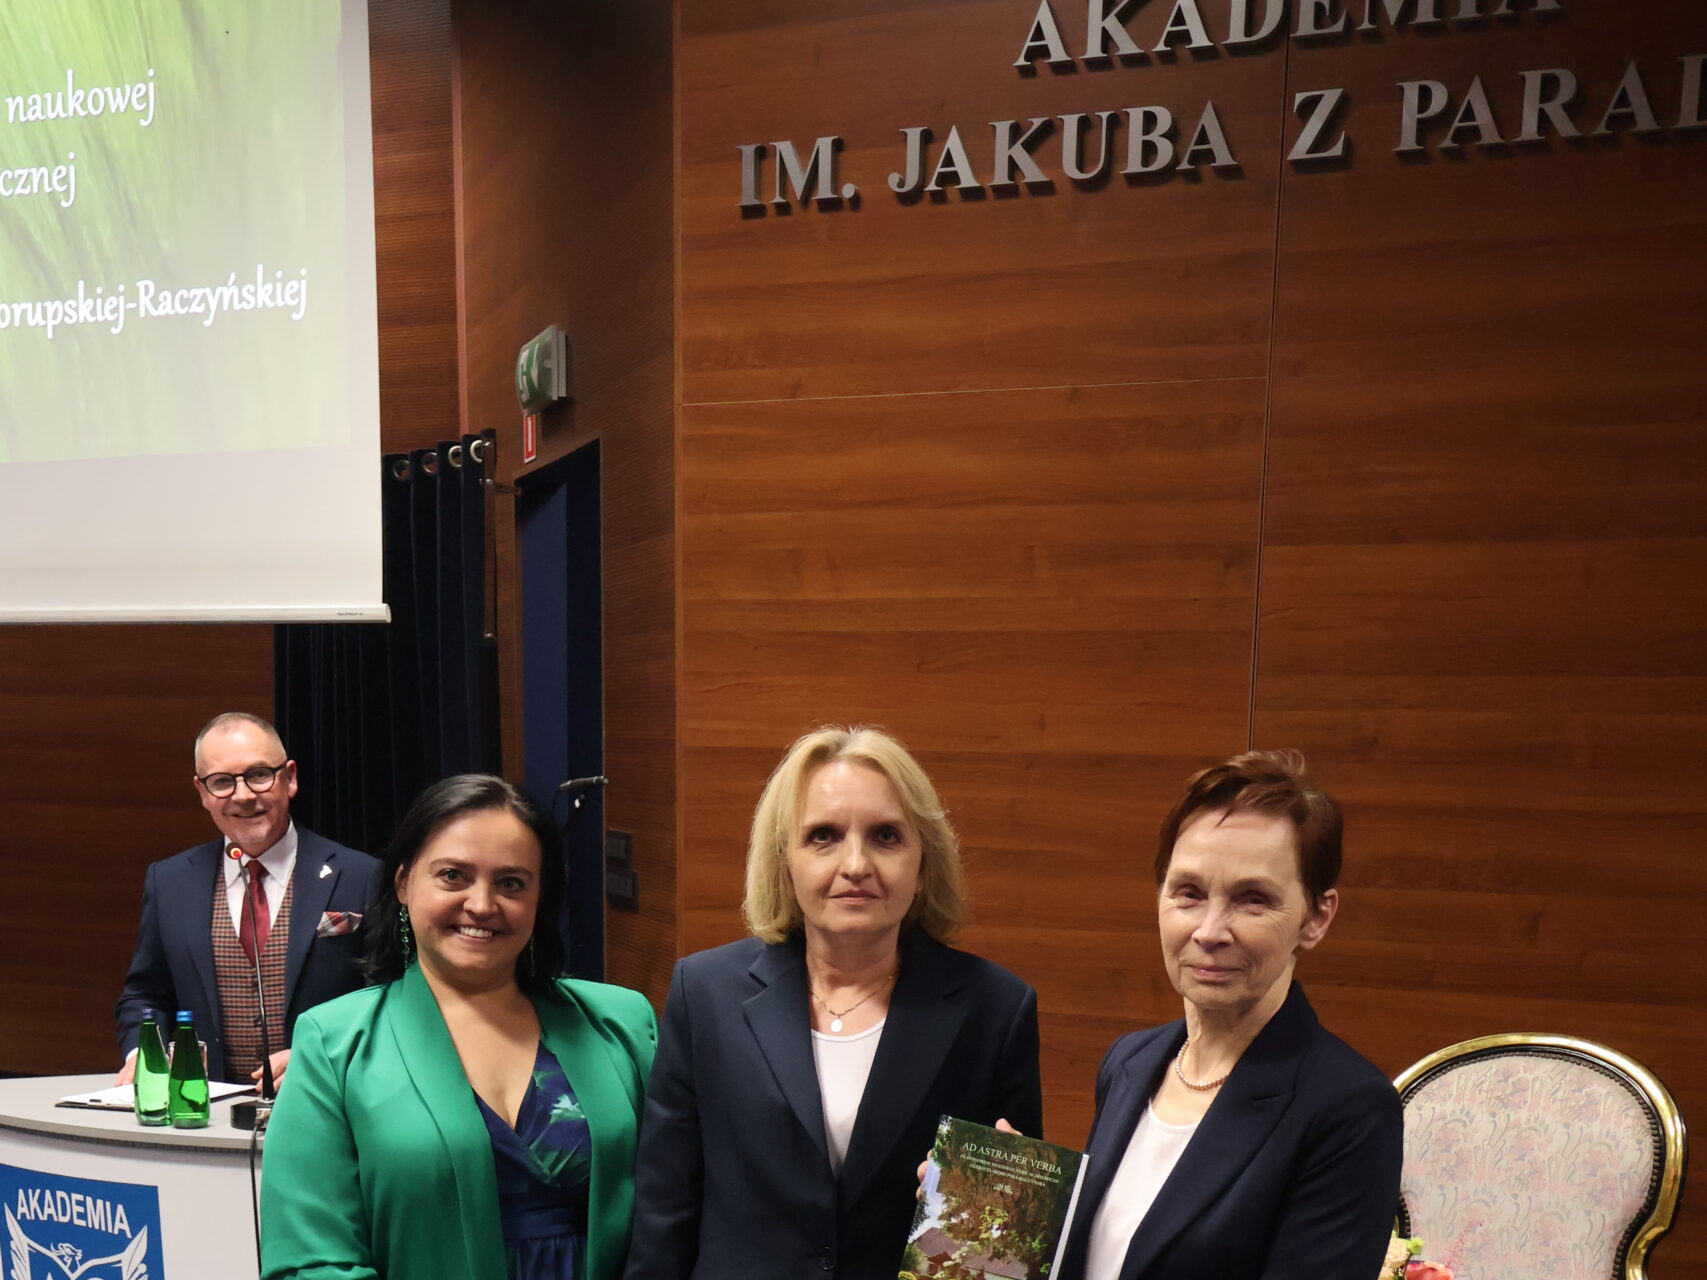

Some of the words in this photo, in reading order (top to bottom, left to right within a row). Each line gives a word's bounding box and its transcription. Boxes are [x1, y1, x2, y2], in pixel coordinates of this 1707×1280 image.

[1013, 0, 1563, 66] AKADE
[7, 69, 155, 127] naukowej
[736, 135, 858, 207] IM.
[888, 100, 1238, 193] JAKUBA
[1287, 88, 1347, 161] Z
[0, 152, 76, 208] cznej
[962, 1142, 977, 1152] AD
[977, 1146, 1008, 1161] ASTRA
[1030, 1159, 1062, 1175] VERBA
[16, 1188, 132, 1239] AKADEMIA
